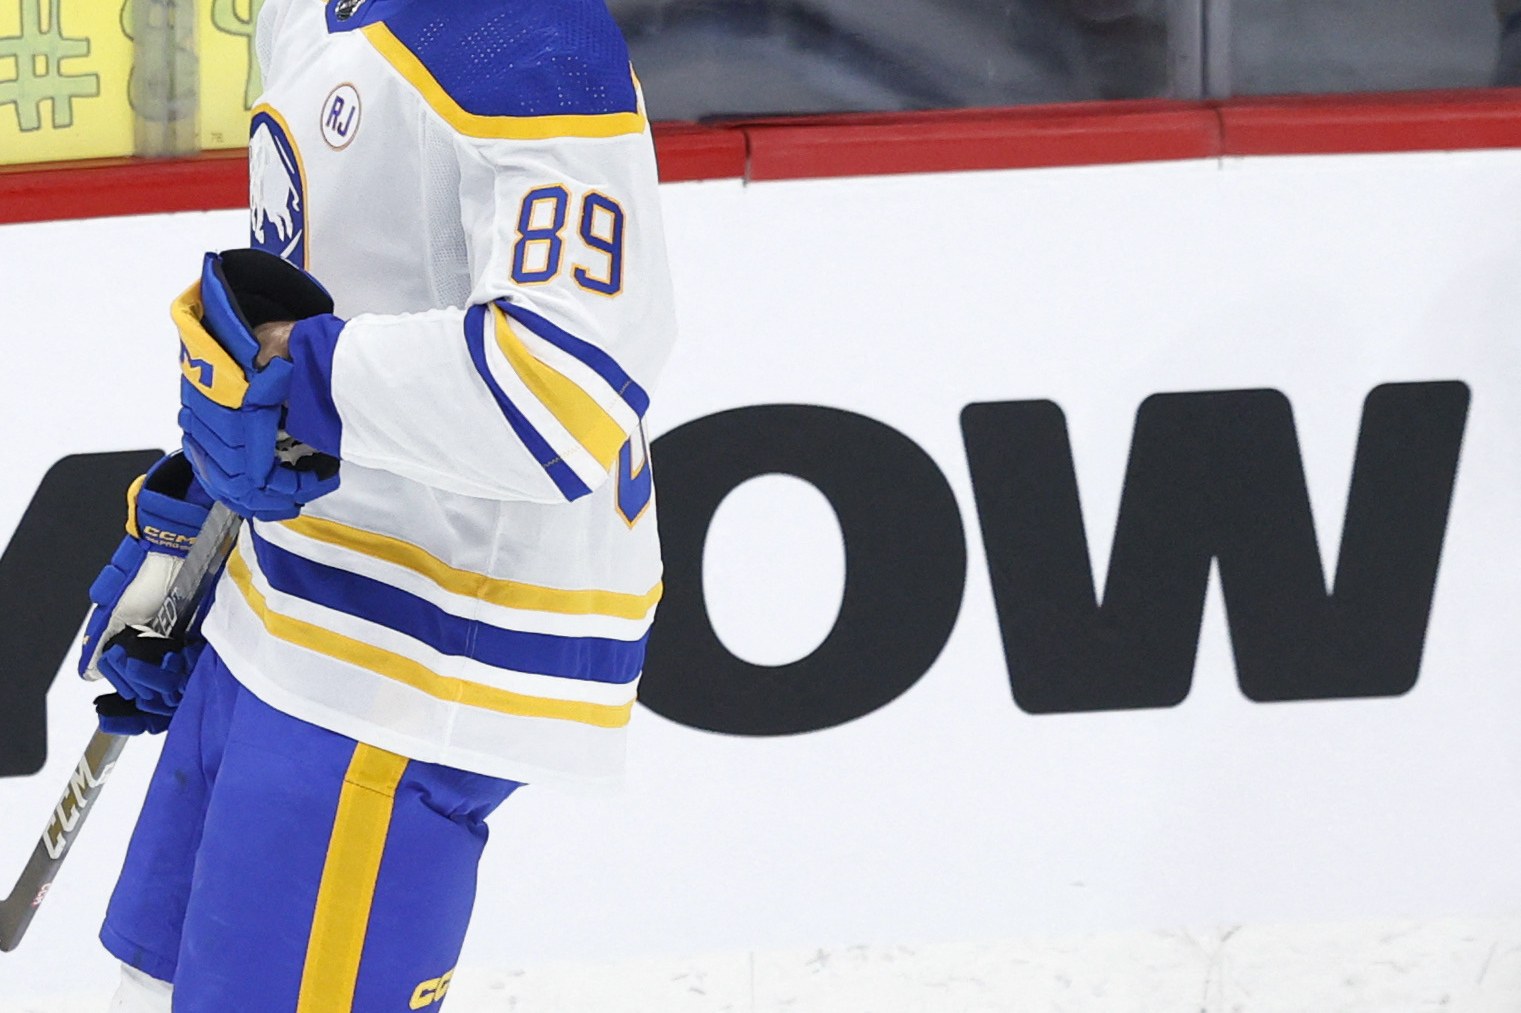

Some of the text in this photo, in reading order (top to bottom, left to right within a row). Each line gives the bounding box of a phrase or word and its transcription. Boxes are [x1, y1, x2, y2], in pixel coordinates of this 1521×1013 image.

[326, 95, 356, 138] RJ
[508, 182, 626, 299] 89
[143, 526, 197, 544] CCM
[43, 753, 105, 859] CCM
